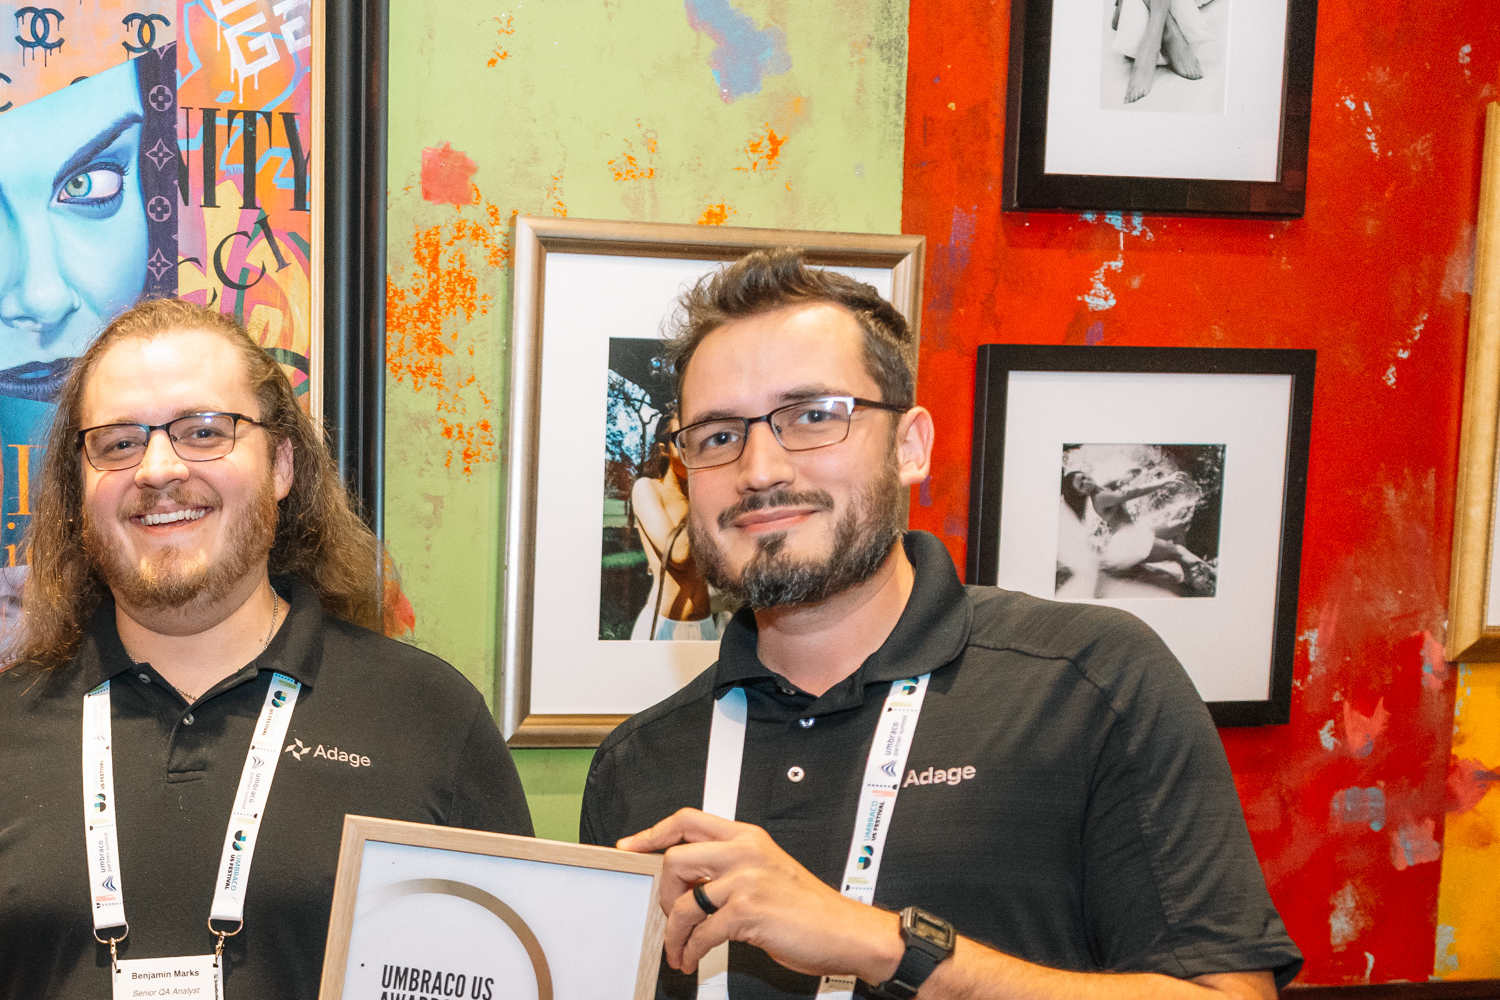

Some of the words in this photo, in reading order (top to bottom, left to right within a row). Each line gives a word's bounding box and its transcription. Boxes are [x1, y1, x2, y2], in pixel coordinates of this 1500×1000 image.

[885, 721, 899, 756] umbraco
[313, 744, 371, 768] Adage
[249, 773, 261, 803] umbraco
[902, 765, 977, 788] Adage
[864, 800, 879, 842] UMBRACO
[873, 801, 885, 830] FESTIVAL
[871, 831, 878, 841] US
[230, 854, 236, 862] US
[225, 863, 233, 890] FESTIVAL
[230, 855, 241, 891] UMBRACO
[132, 970, 171, 980] Benjamin
[174, 969, 200, 978] Marks
[381, 964, 466, 998] UMBRACO
[471, 976, 495, 1000] US
[133, 988, 156, 997] Senior
[159, 988, 171, 996] QA
[173, 987, 200, 996] Analyst
